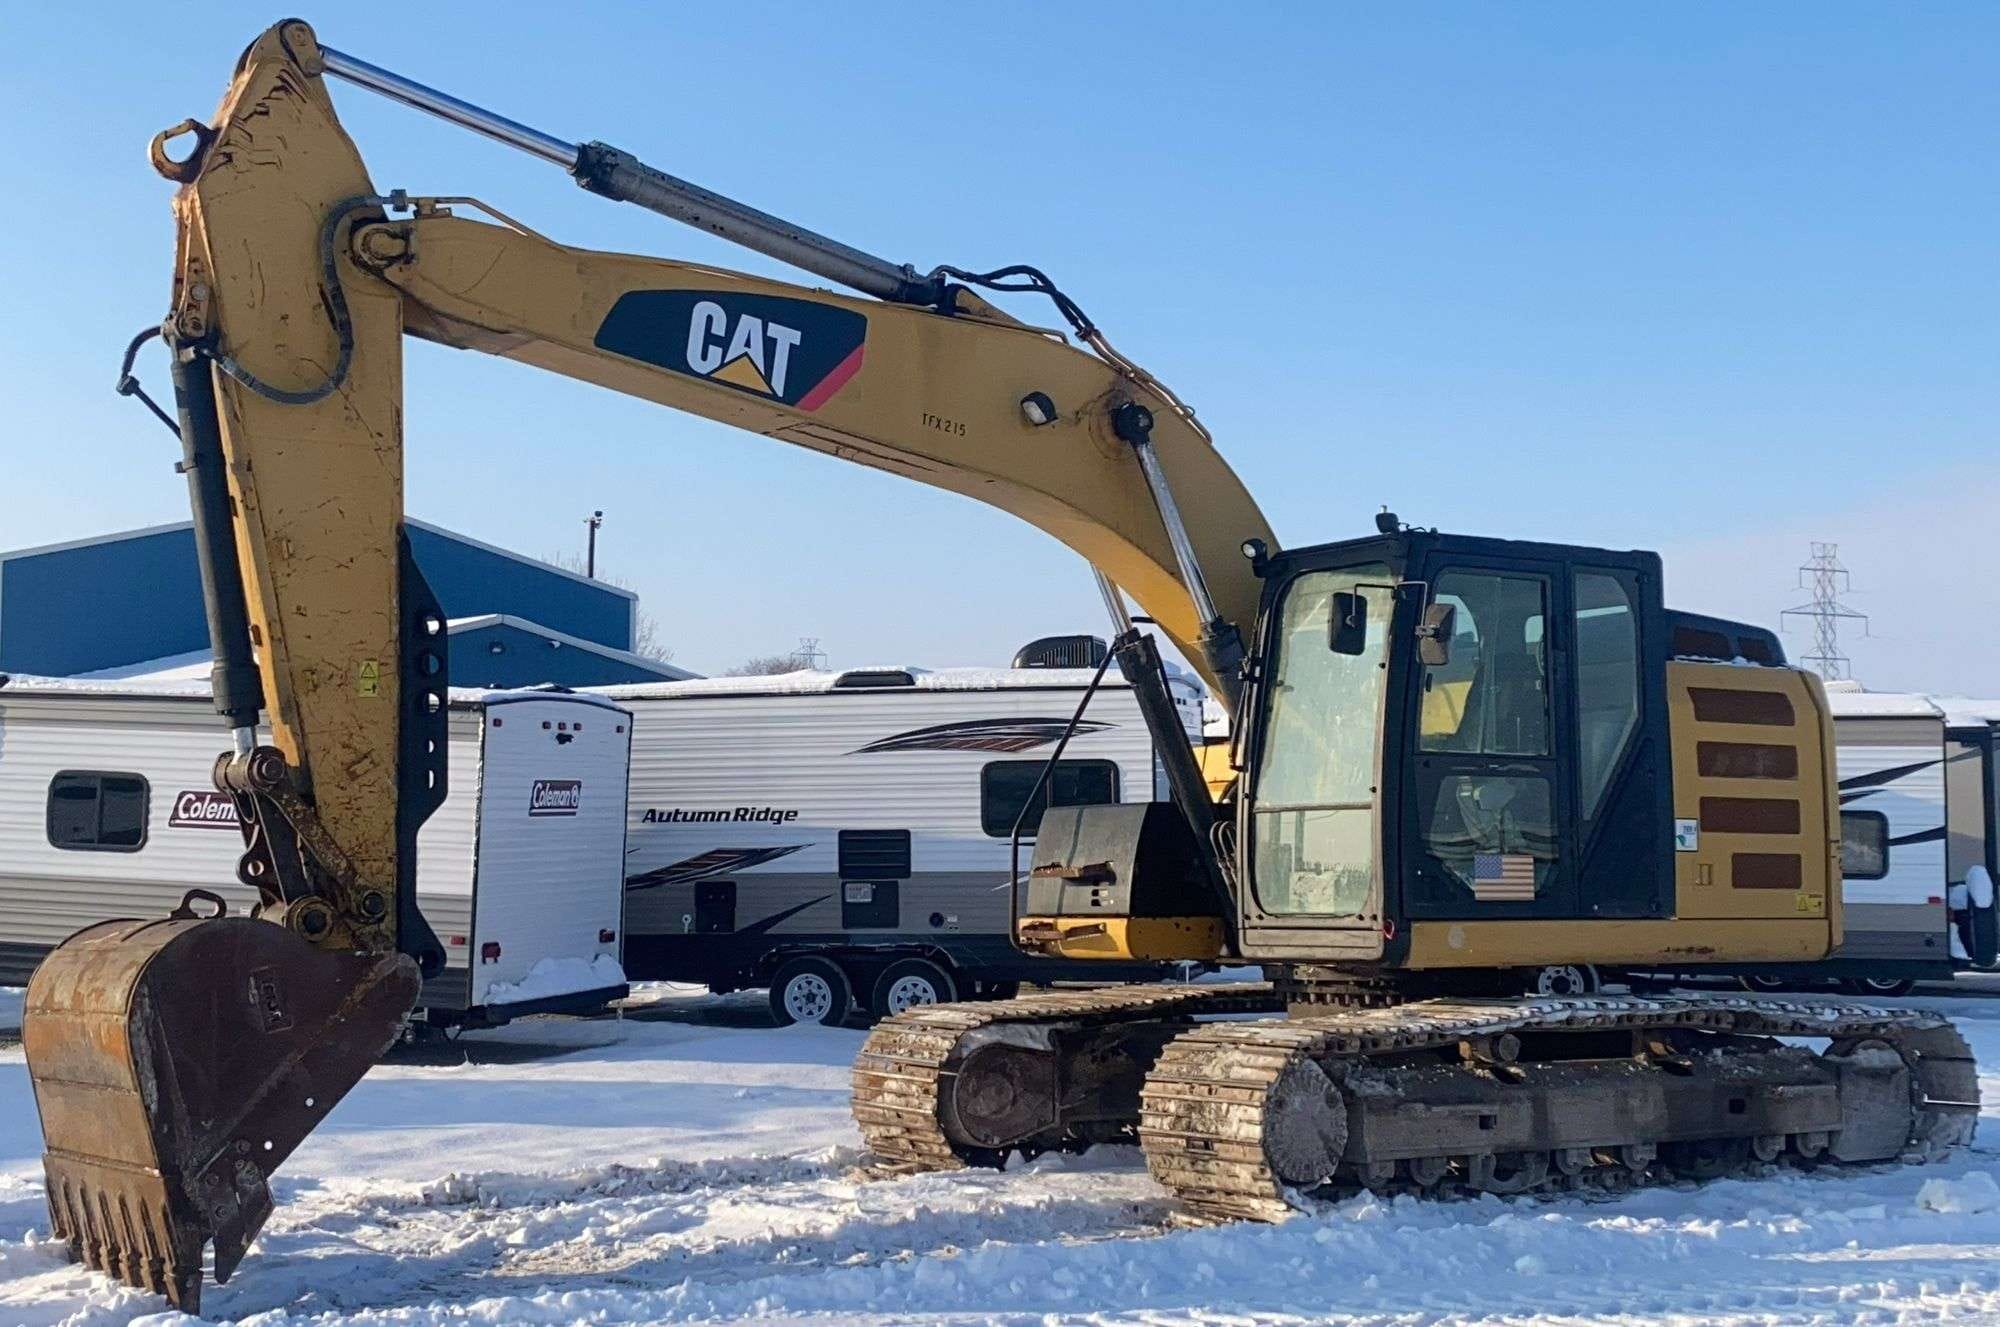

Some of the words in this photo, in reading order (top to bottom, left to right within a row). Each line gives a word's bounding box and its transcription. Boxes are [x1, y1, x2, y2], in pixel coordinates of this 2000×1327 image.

[687, 301, 801, 397] CAT
[533, 783, 571, 807] Coleman
[642, 808, 731, 823] Autumn
[732, 807, 798, 825] Ridge
